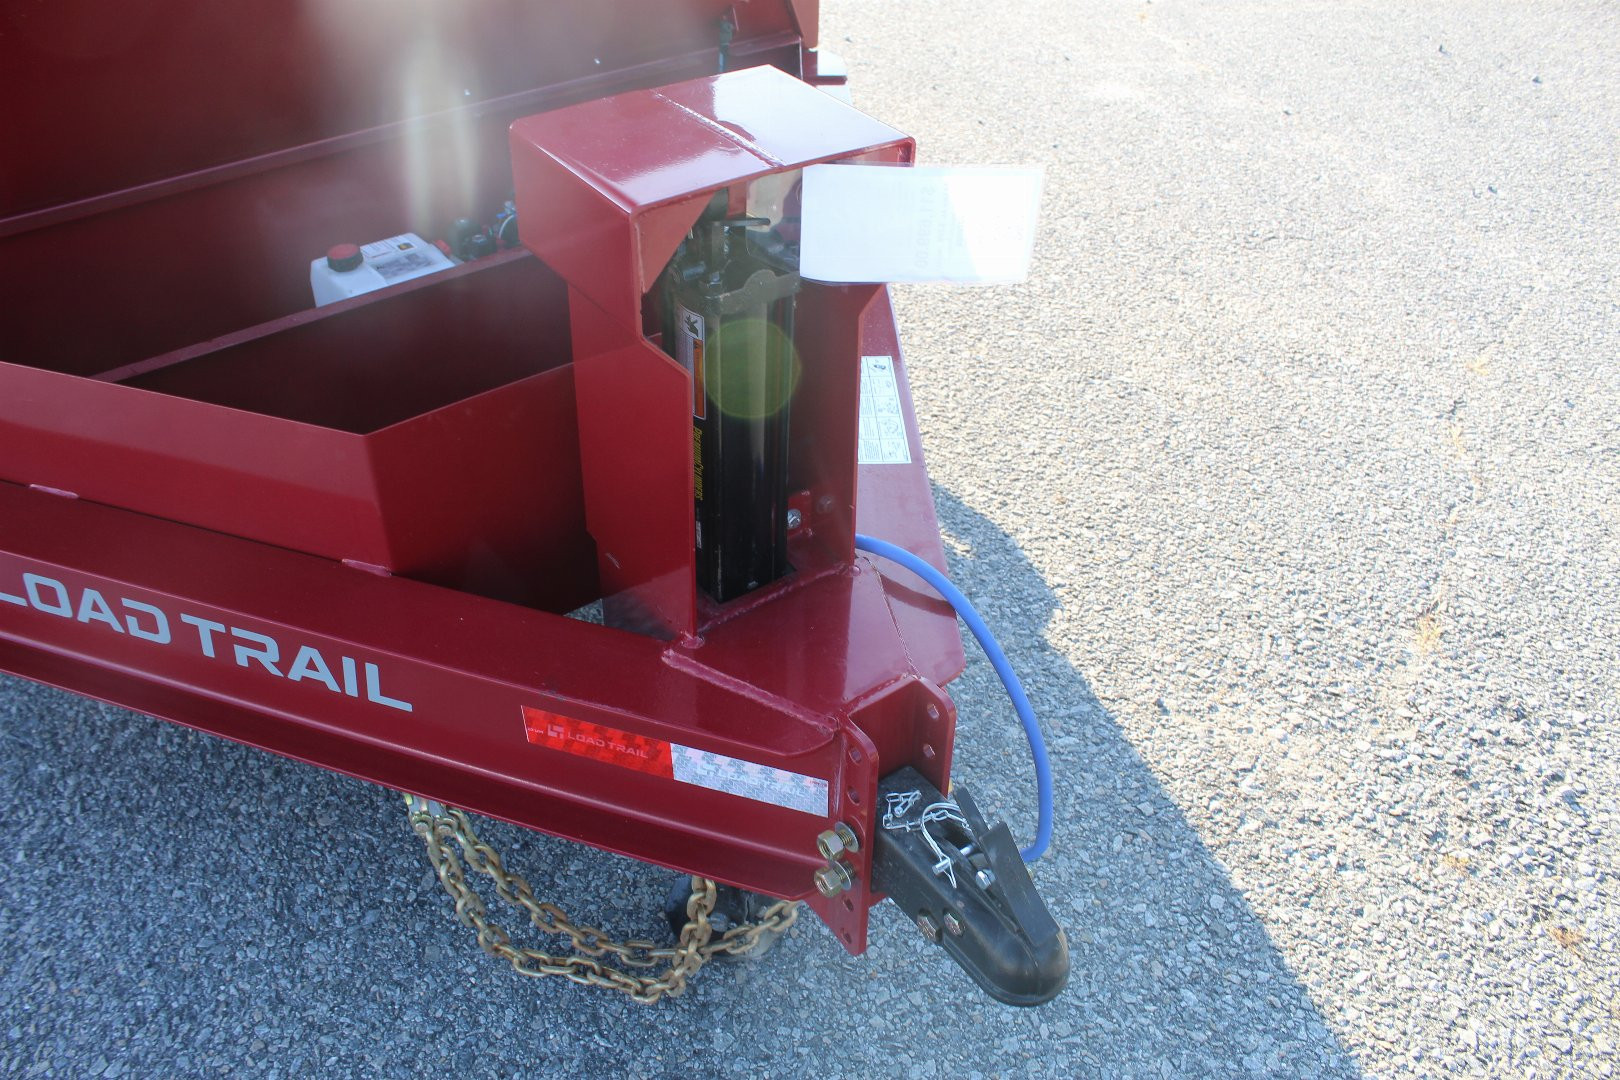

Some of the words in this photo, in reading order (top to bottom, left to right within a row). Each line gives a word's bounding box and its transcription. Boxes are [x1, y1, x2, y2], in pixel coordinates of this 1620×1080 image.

[180, 613, 413, 713] TRAIL
[567, 731, 606, 748] LOAD
[607, 741, 649, 759] TRAIL
